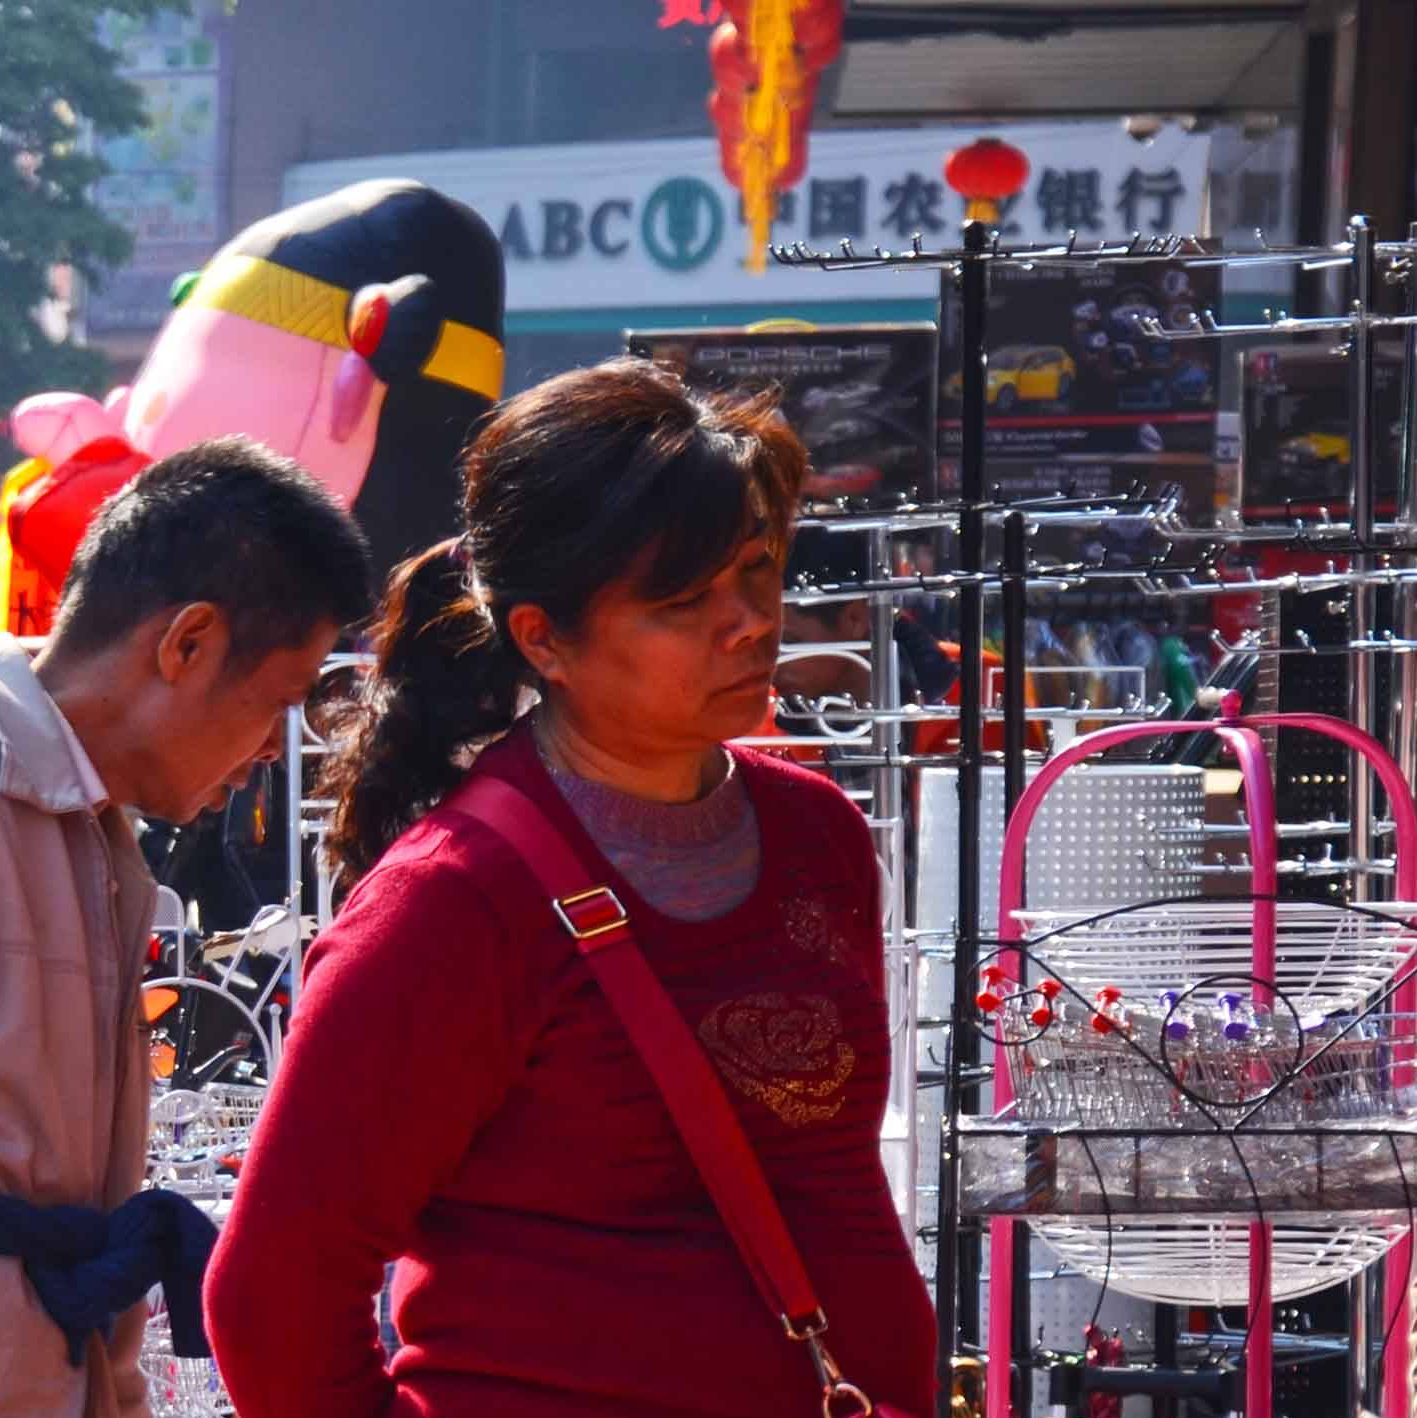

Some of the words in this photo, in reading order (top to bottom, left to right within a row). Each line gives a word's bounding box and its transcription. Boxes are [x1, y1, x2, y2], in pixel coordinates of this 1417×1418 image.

[500, 199, 635, 259] ABC
[739, 166, 1187, 238] 国农银行
